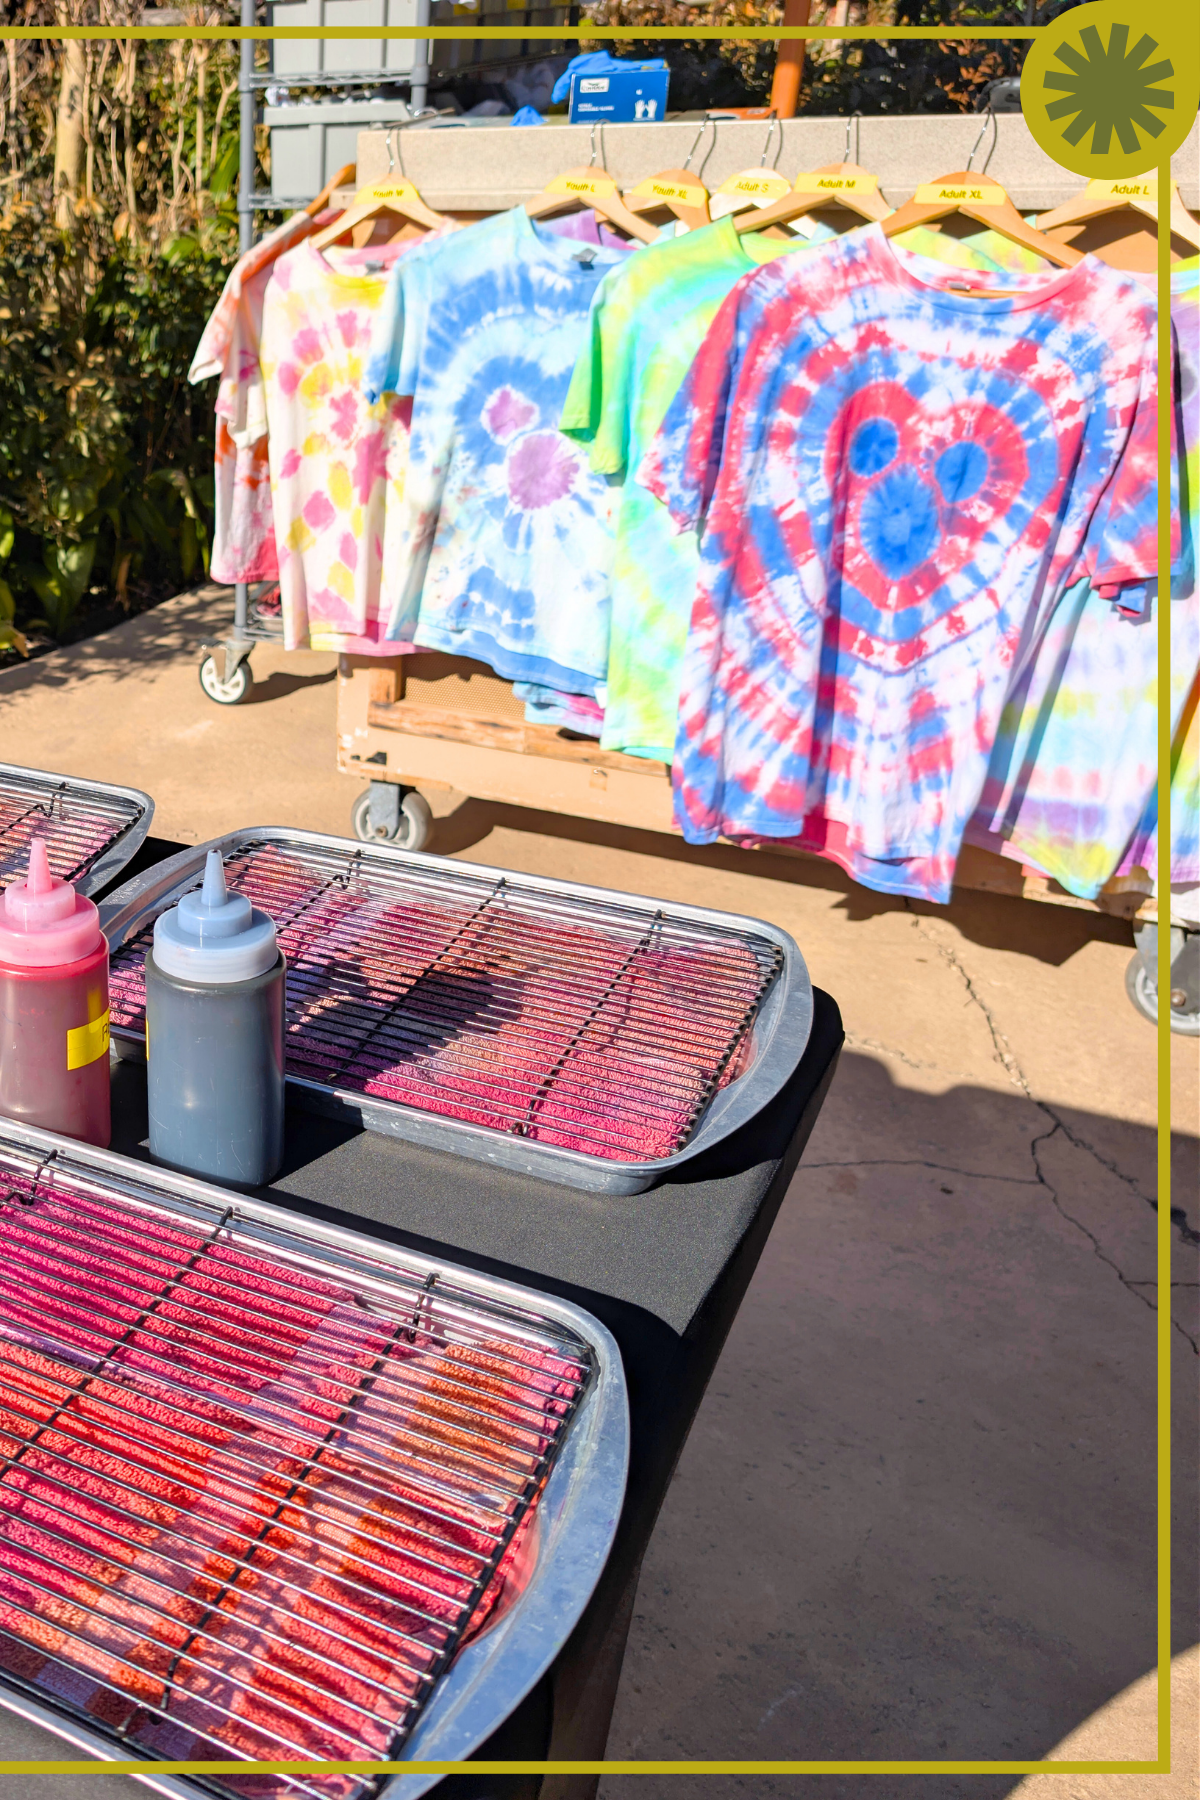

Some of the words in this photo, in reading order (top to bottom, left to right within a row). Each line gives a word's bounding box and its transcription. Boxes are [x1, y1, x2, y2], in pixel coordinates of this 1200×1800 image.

[735, 181, 760, 192] Adult
[817, 179, 843, 189] Adult
[844, 180, 856, 189] M
[938, 189, 968, 199] Adult
[968, 190, 984, 200] XL
[1110, 184, 1141, 195] Adult
[1142, 185, 1150, 196] L
